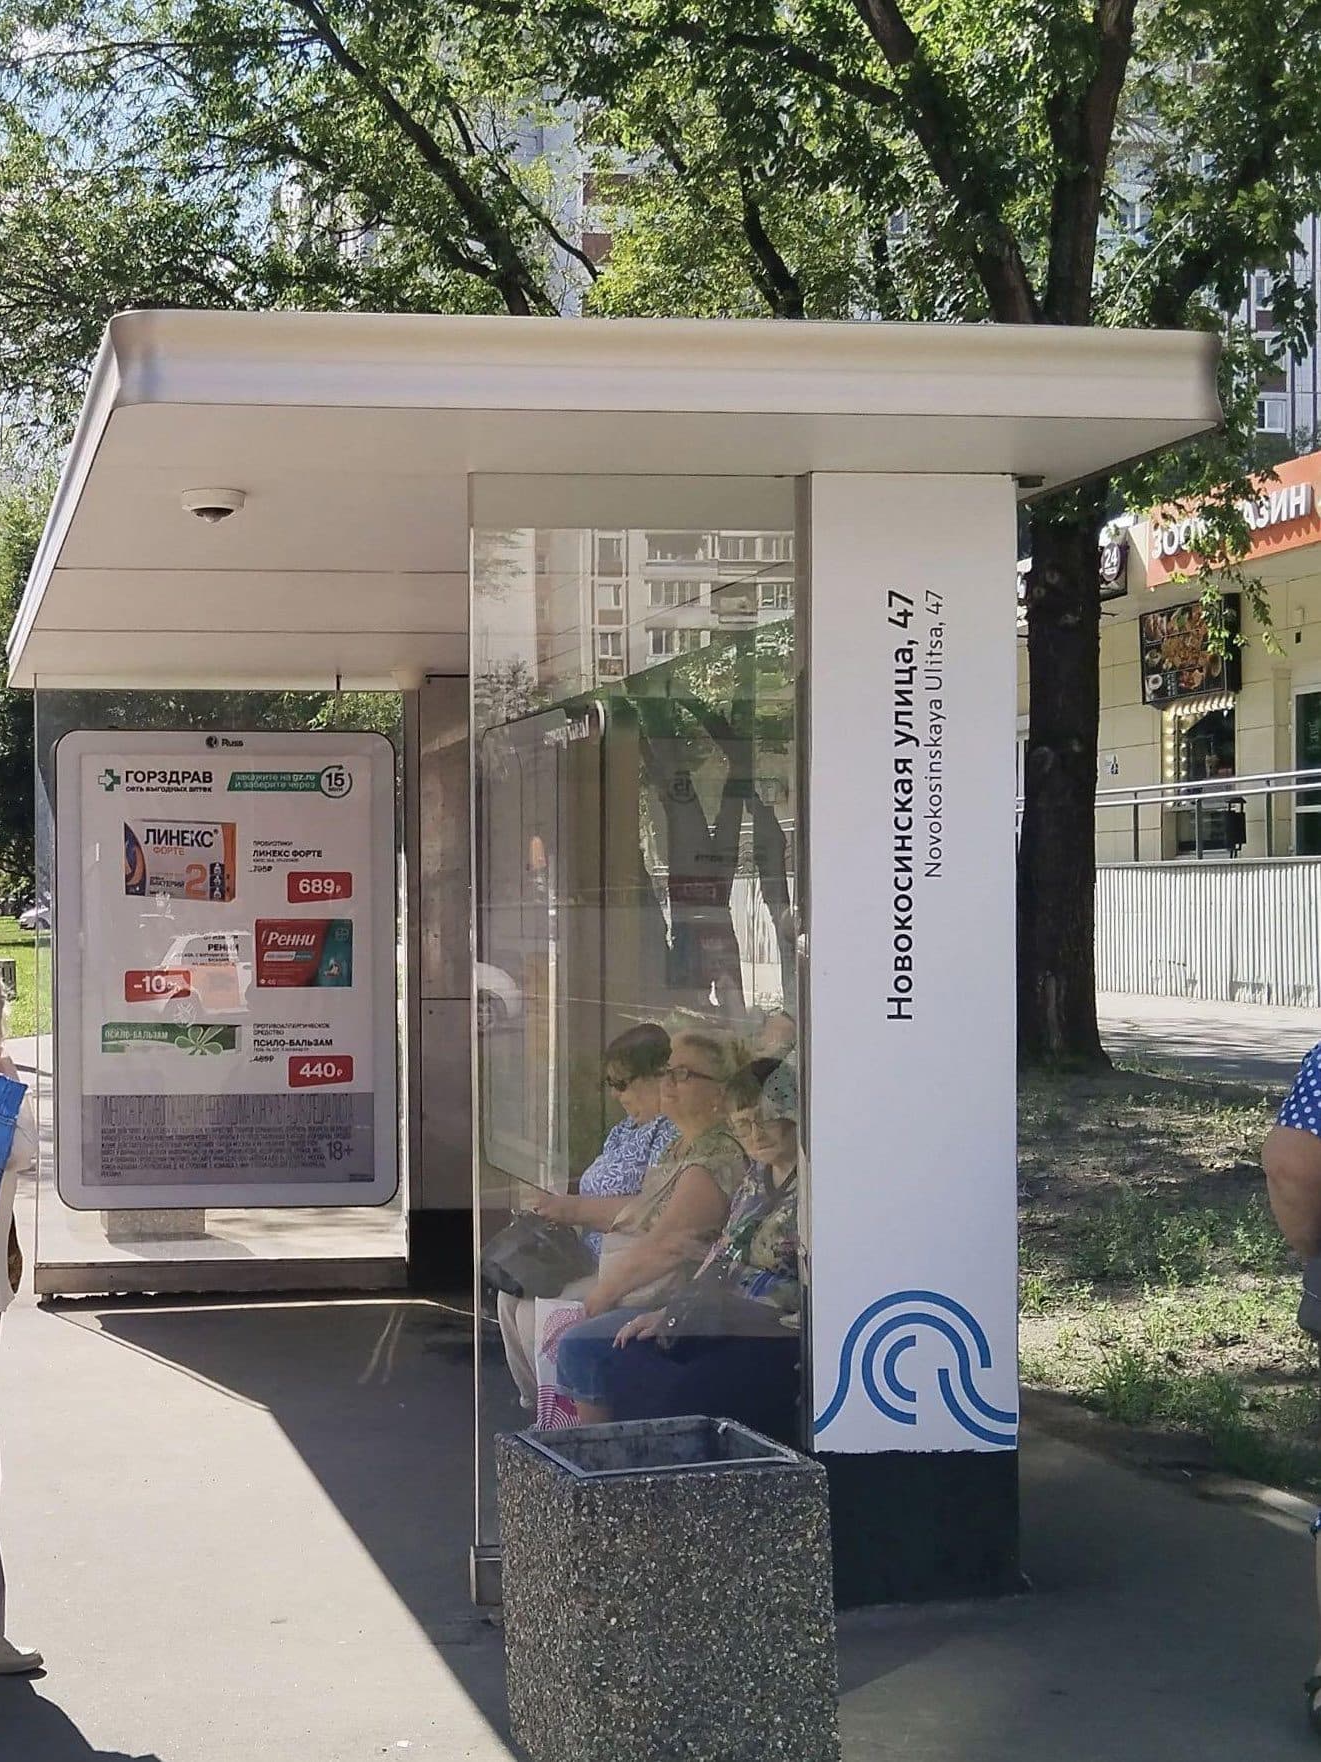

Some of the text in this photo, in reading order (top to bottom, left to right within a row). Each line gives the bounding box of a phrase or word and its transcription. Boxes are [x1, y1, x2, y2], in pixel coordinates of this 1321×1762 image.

[1151, 484, 1312, 560] ЗООМАЗИН
[1104, 546, 1119, 569] 24
[923, 589, 947, 879] Novokosinskaya Ulitsa, 47
[221, 738, 244, 747] Russ
[125, 770, 213, 785] ГОРЗДРАВ
[243, 781, 286, 789] заберите
[293, 774, 316, 782] gz.ru
[326, 772, 345, 787] 15
[887, 589, 920, 1021] Новокосинская улица, 47
[144, 828, 214, 848] ЛИНЕКС
[153, 846, 185, 856] ФОРТЕ
[252, 849, 323, 858] ЛИНЕКС ФОРТЕ
[185, 863, 207, 898] 2
[266, 931, 316, 947] Ренни
[104, 1030, 169, 1040] ПСИЛО-БАЛЬЗАМ
[253, 1039, 333, 1047] ПСИЛО-БАЛЬЗАМ
[327, 1140, 354, 1161] 18+
